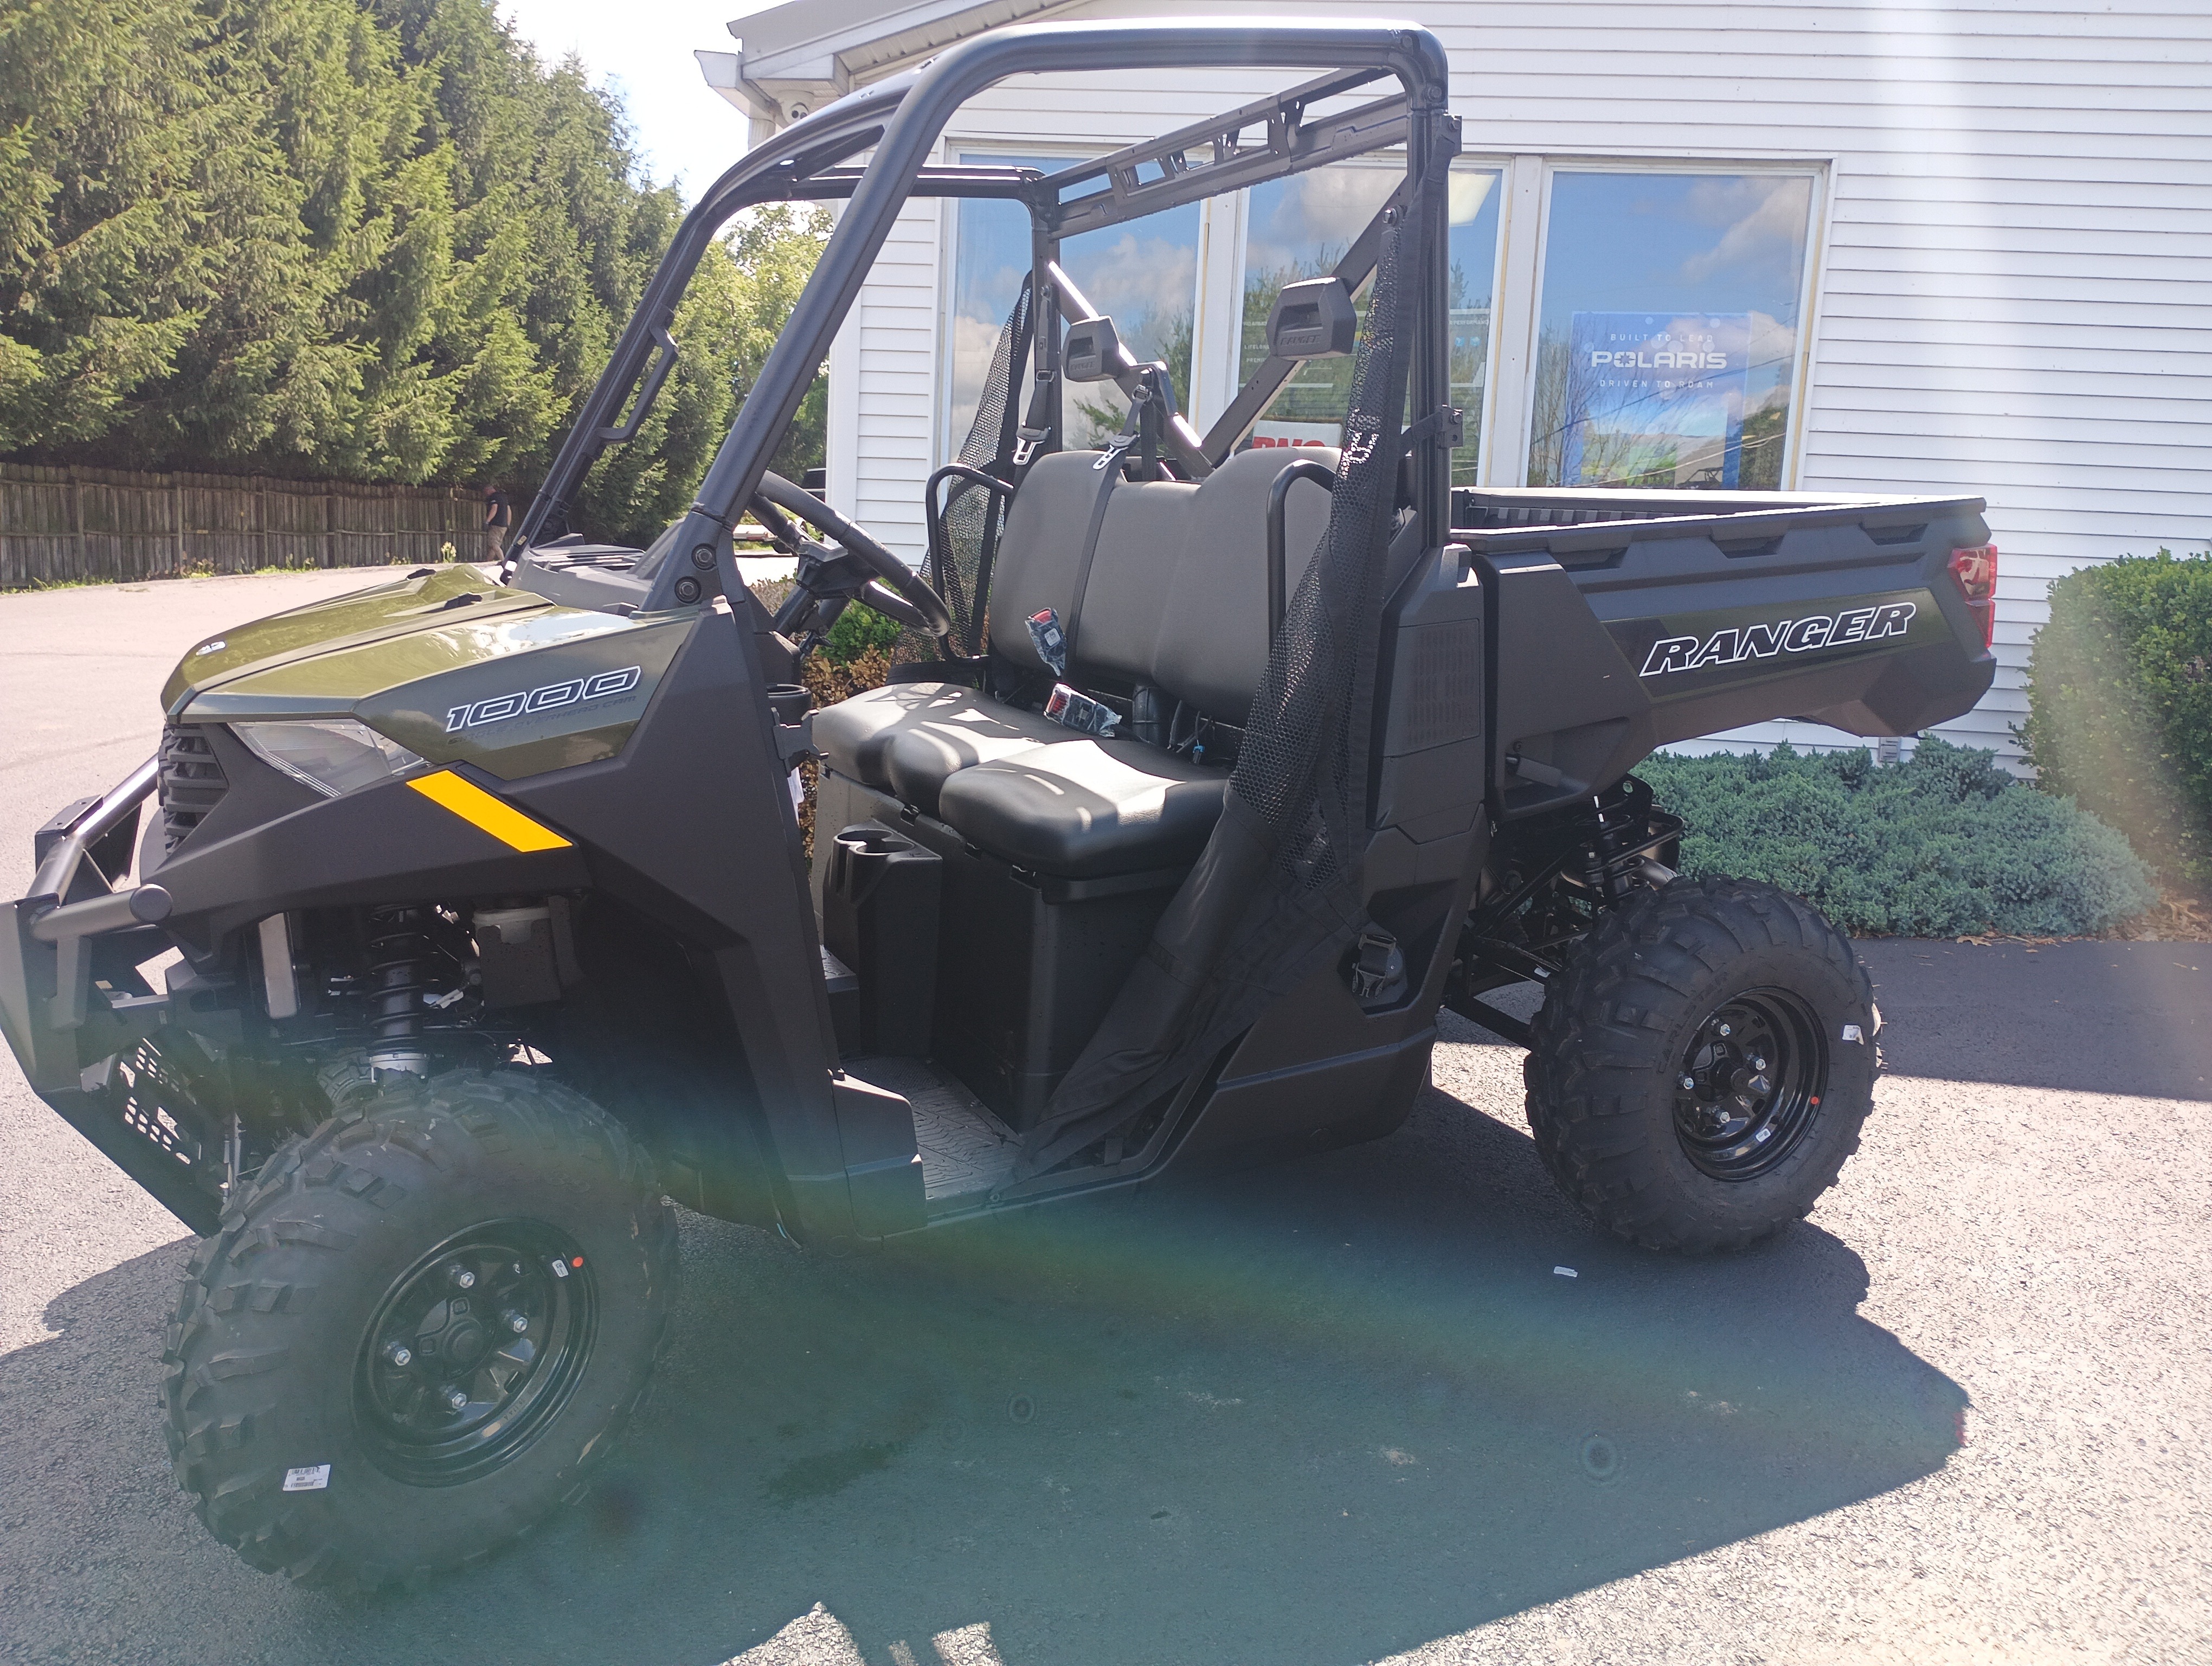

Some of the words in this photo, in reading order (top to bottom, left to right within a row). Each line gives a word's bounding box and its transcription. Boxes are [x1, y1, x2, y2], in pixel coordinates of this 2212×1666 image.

[1657, 334, 1671, 342] TO
[1680, 334, 1713, 342] LEAD
[1591, 351, 1727, 369] POLARIS
[1600, 380, 1648, 388] DRIVEN
[1639, 602, 1917, 677] RANGER
[446, 665, 641, 733] 1000
